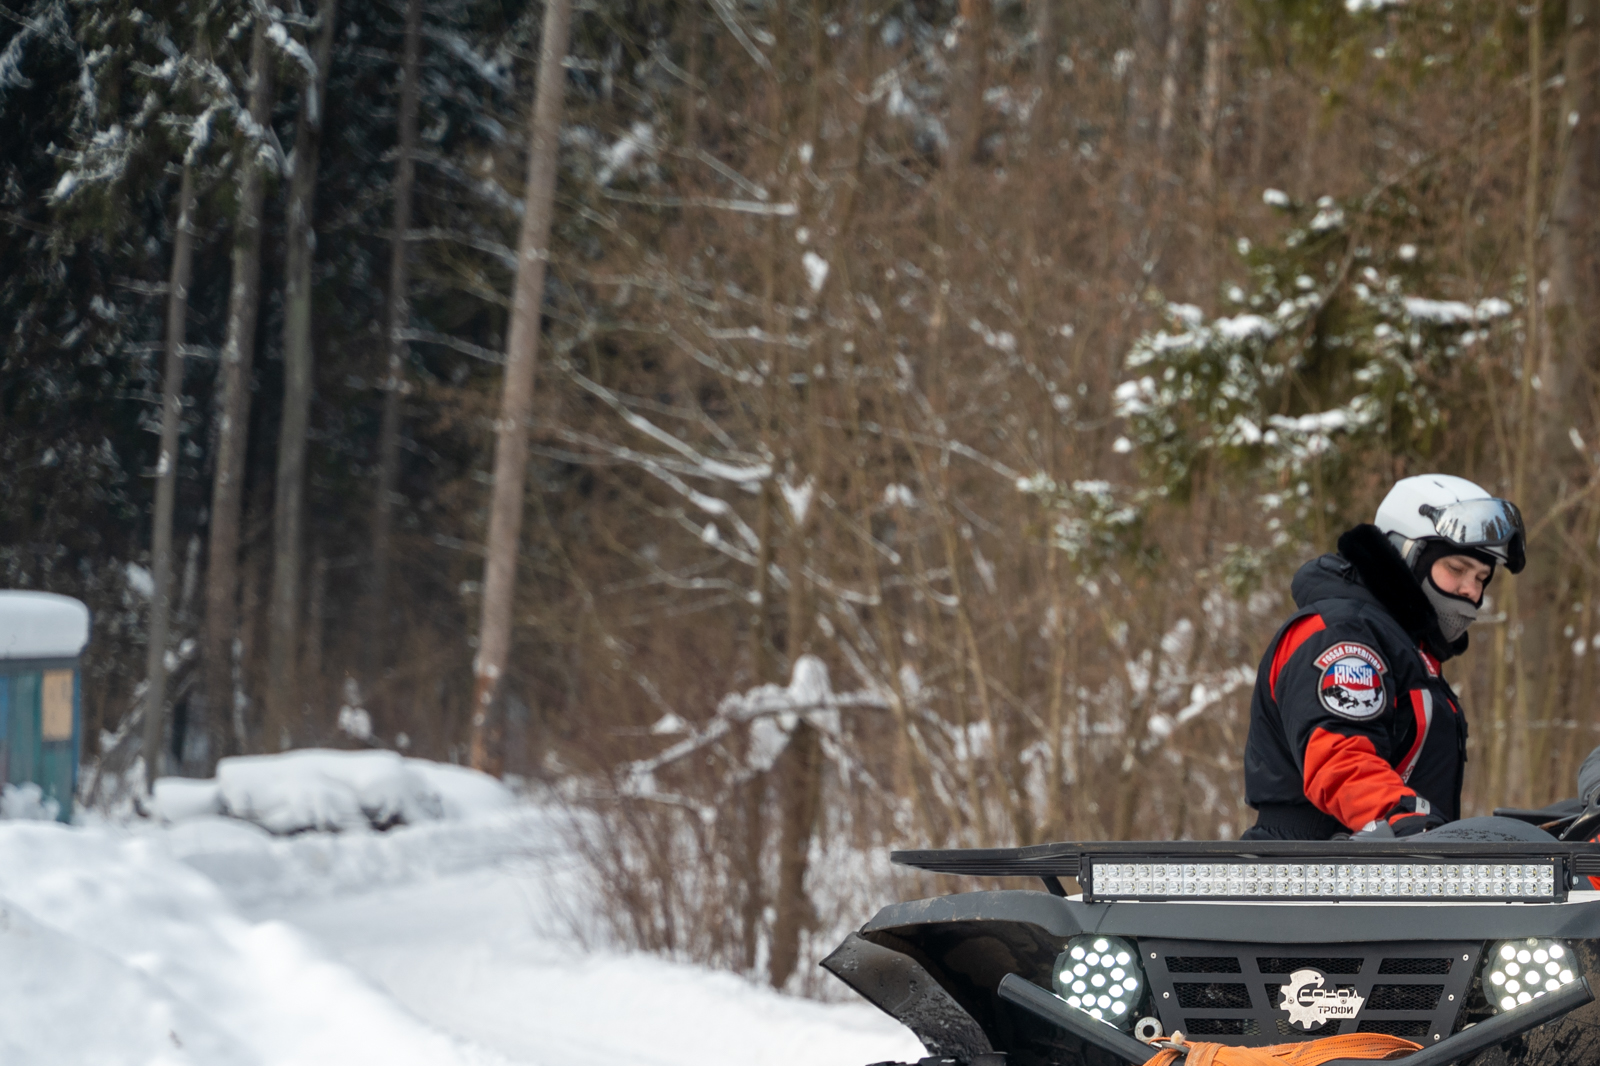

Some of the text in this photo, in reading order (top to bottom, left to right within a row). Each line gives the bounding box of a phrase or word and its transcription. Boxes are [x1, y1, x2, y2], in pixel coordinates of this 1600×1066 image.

[1322, 645, 1381, 670] FOSSA EXPEDITION
[1318, 1006, 1354, 1014] ТРОФИ
